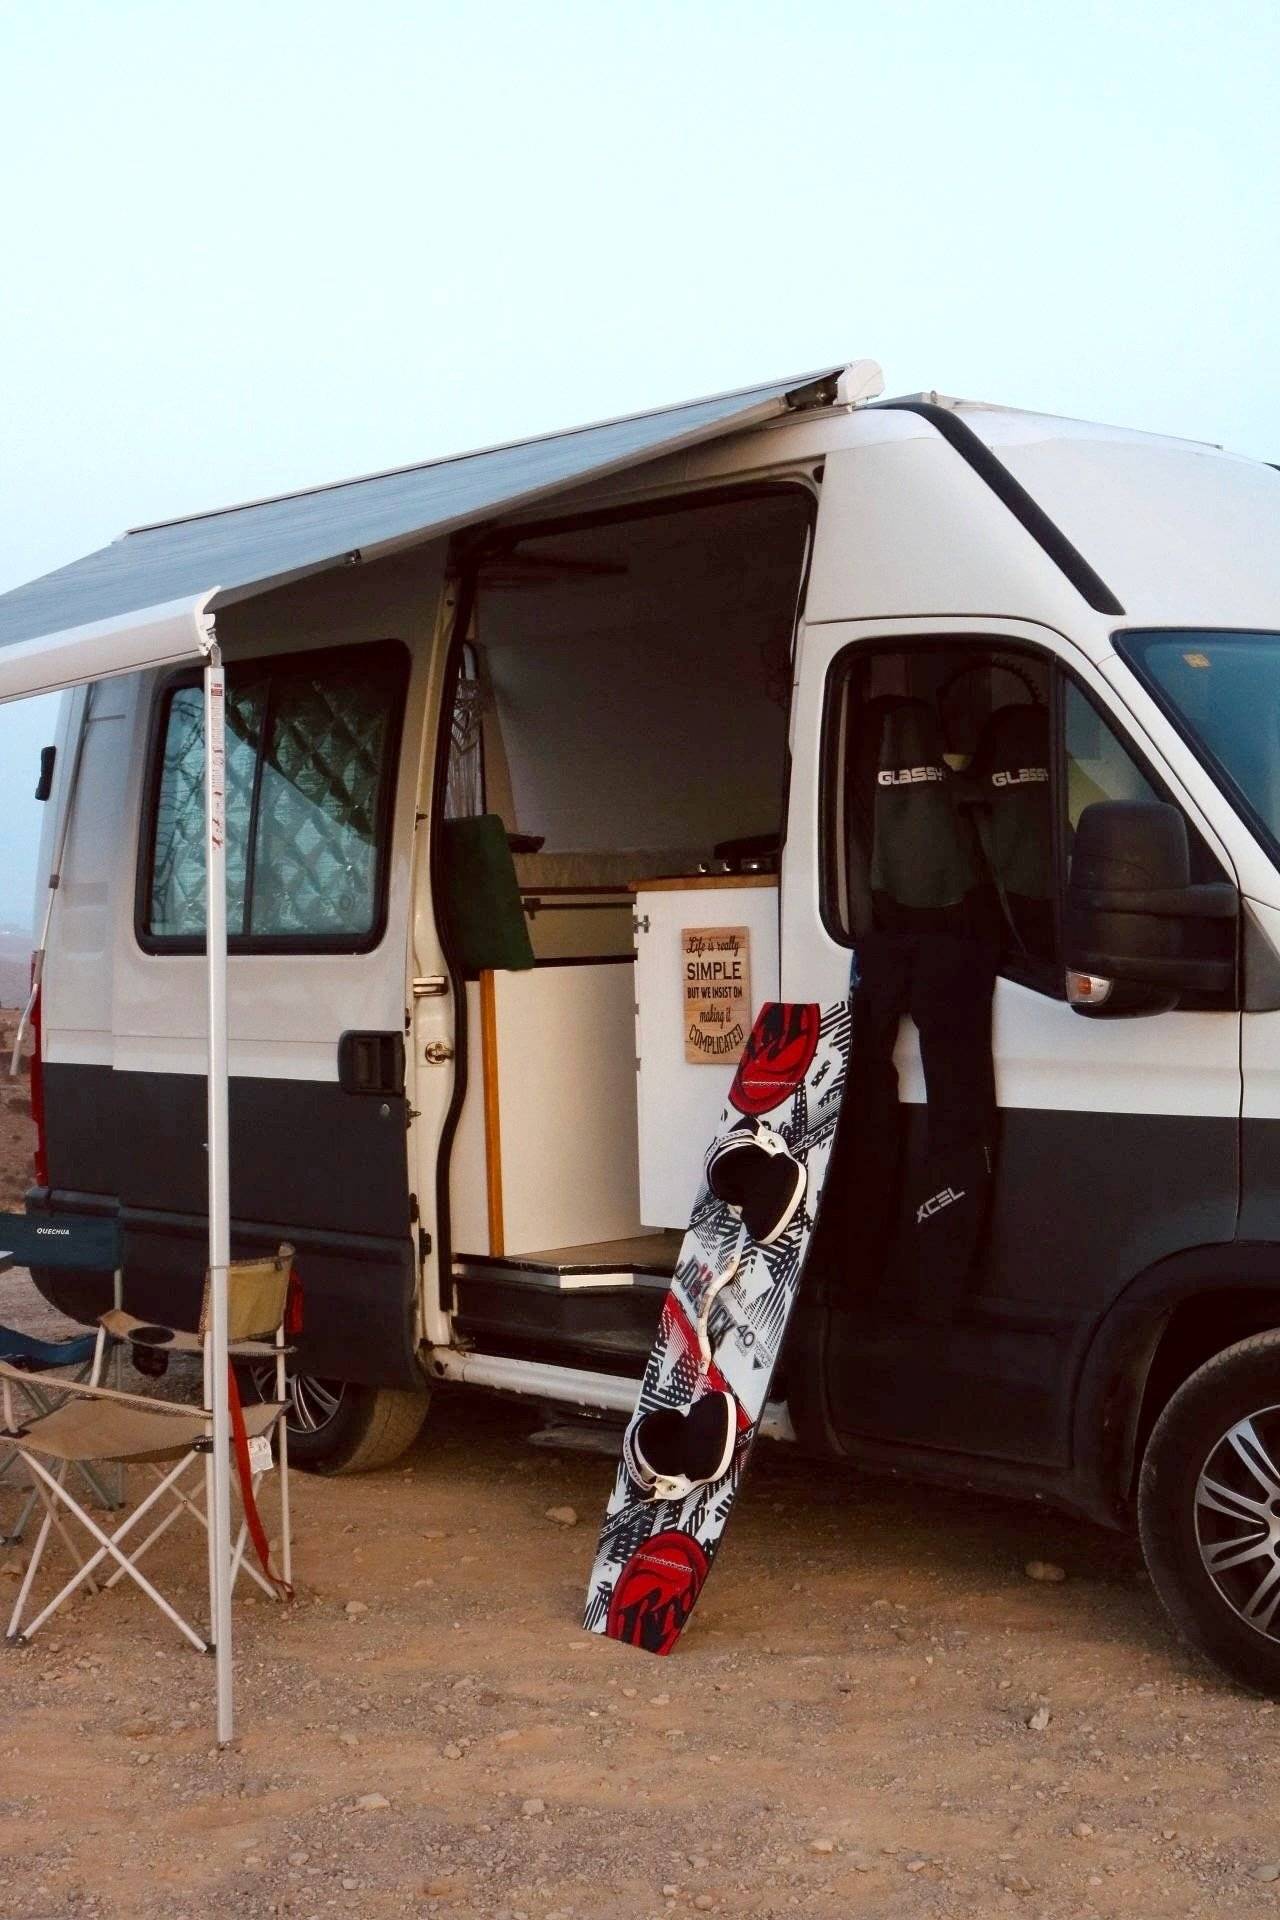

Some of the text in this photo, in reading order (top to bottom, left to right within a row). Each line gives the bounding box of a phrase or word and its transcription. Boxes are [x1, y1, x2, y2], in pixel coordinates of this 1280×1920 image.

[686, 935, 740, 958] Life is really
[687, 961, 742, 981] SIMPLE
[687, 985, 743, 999] BUT WE INSIST ON
[699, 1003, 731, 1030] making it
[688, 1023, 744, 1055] COMPLICATED
[916, 1187, 966, 1224] XCEL
[36, 1227, 70, 1235] QUECHUA
[736, 1324, 755, 1347] 40
